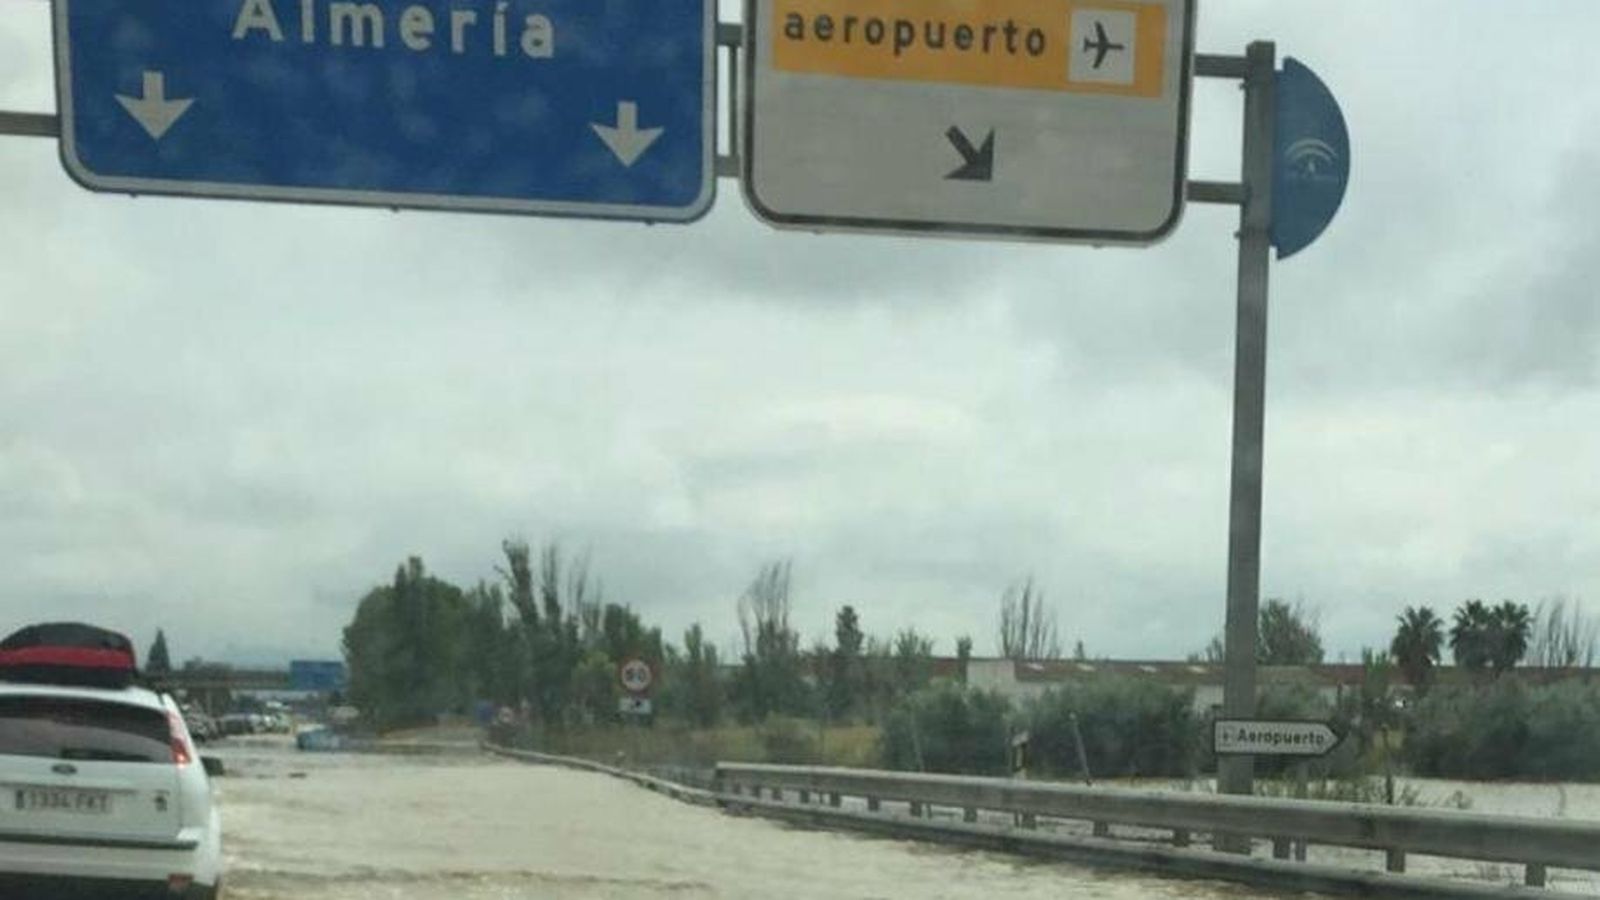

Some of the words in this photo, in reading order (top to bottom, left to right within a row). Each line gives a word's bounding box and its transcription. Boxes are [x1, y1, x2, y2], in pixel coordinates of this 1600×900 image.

[232, 0, 554, 58] Almería
[784, 11, 1046, 57] aeropuerto
[1237, 728, 1325, 746] Aeropuerto
